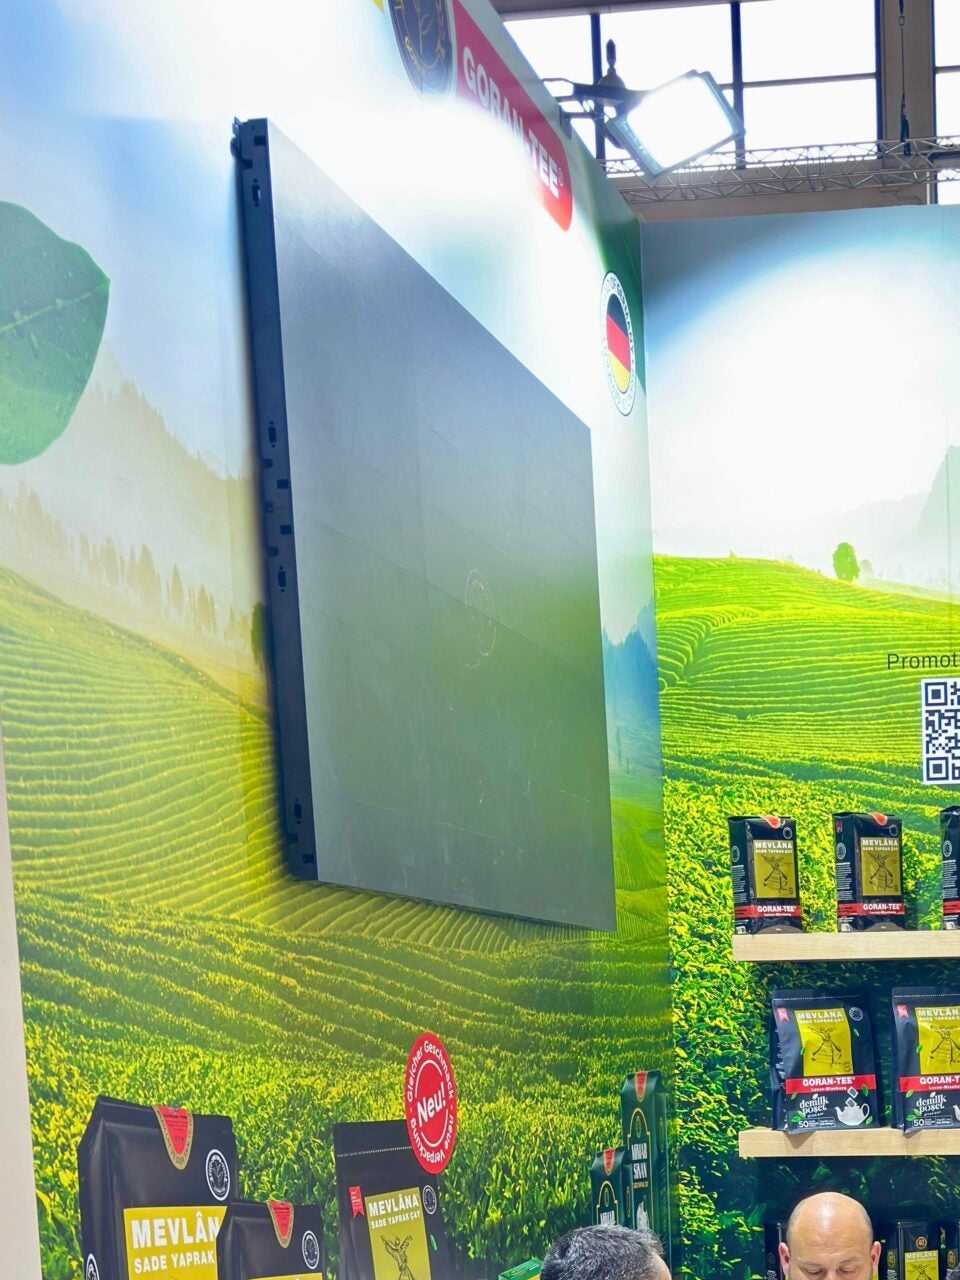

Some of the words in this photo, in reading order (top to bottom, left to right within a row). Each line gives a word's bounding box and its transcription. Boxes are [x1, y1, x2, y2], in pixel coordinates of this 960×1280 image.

[407, 1047, 423, 1102] Gleicher
[424, 1040, 454, 1099] Geschmack
[416, 1082, 446, 1128] Neu!
[410, 1117, 446, 1164] Verpackung
[444, 1113, 454, 1150] neue
[368, 1193, 419, 1217] MEVLÂNA
[370, 1218, 387, 1229] SADE
[388, 1214, 409, 1225] YAPRAK
[409, 1210, 421, 1222] ÇAY
[131, 1210, 220, 1249] MEVLÂN
[133, 1254, 167, 1274] SADE
[171, 1250, 215, 1269] YAPRAK
